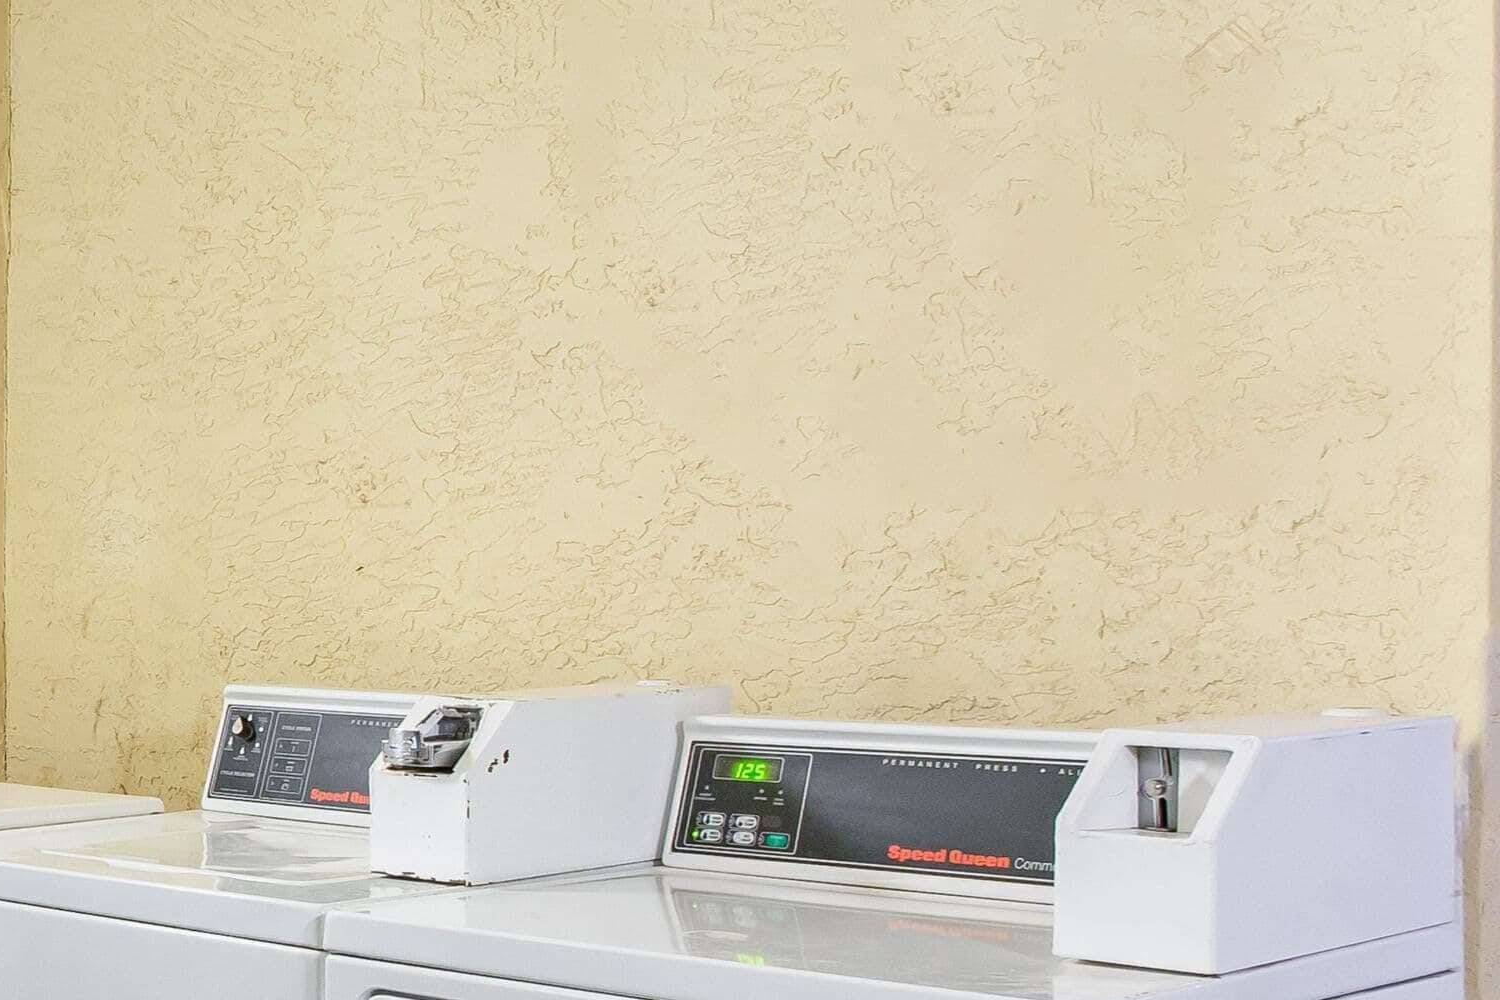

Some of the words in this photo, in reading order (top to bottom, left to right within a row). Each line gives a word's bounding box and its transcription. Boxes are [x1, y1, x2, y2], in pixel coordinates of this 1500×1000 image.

[735, 763, 768, 780] 125
[882, 758, 959, 770] PERMANENT
[975, 763, 1019, 773] PRESS
[310, 787, 349, 803] Speed
[887, 844, 947, 863] Speed
[949, 849, 1011, 868] Queen
[1014, 857, 1055, 872] Comm
